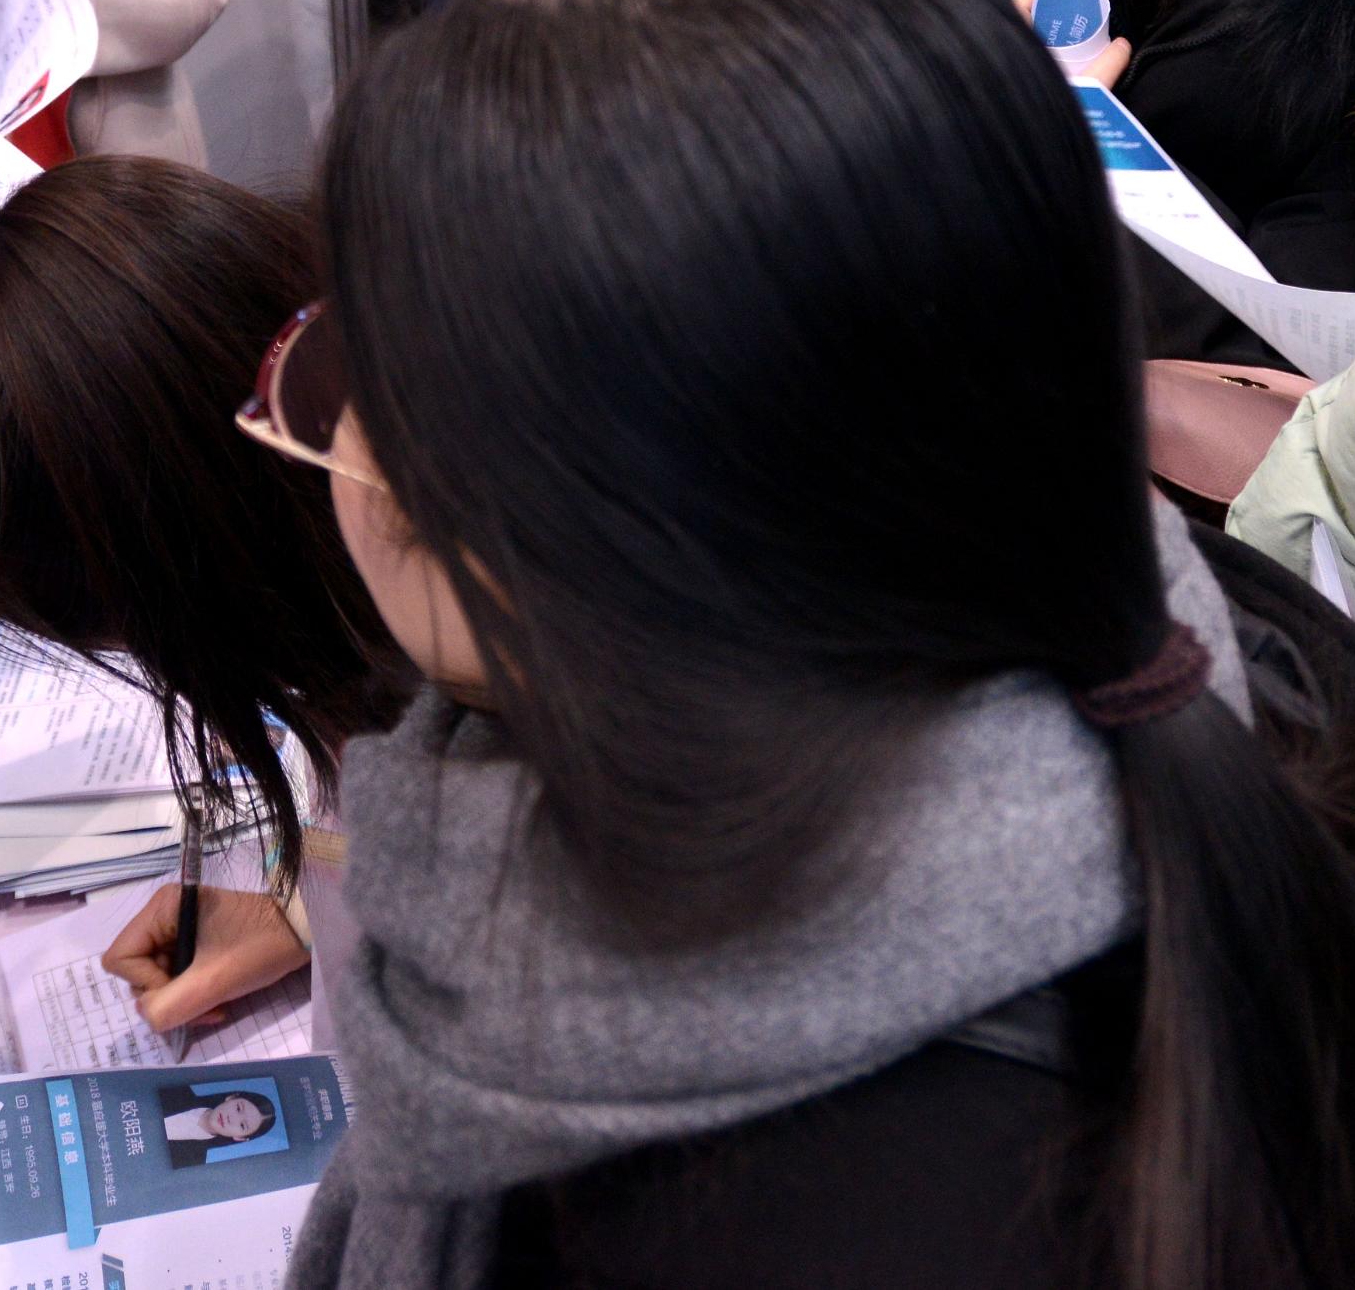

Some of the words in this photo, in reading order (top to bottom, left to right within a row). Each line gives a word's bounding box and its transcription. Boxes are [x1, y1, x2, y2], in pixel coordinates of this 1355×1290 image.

[54, 1092, 79, 1165] 基础信息
[119, 1100, 146, 1158] 欧阳燕
